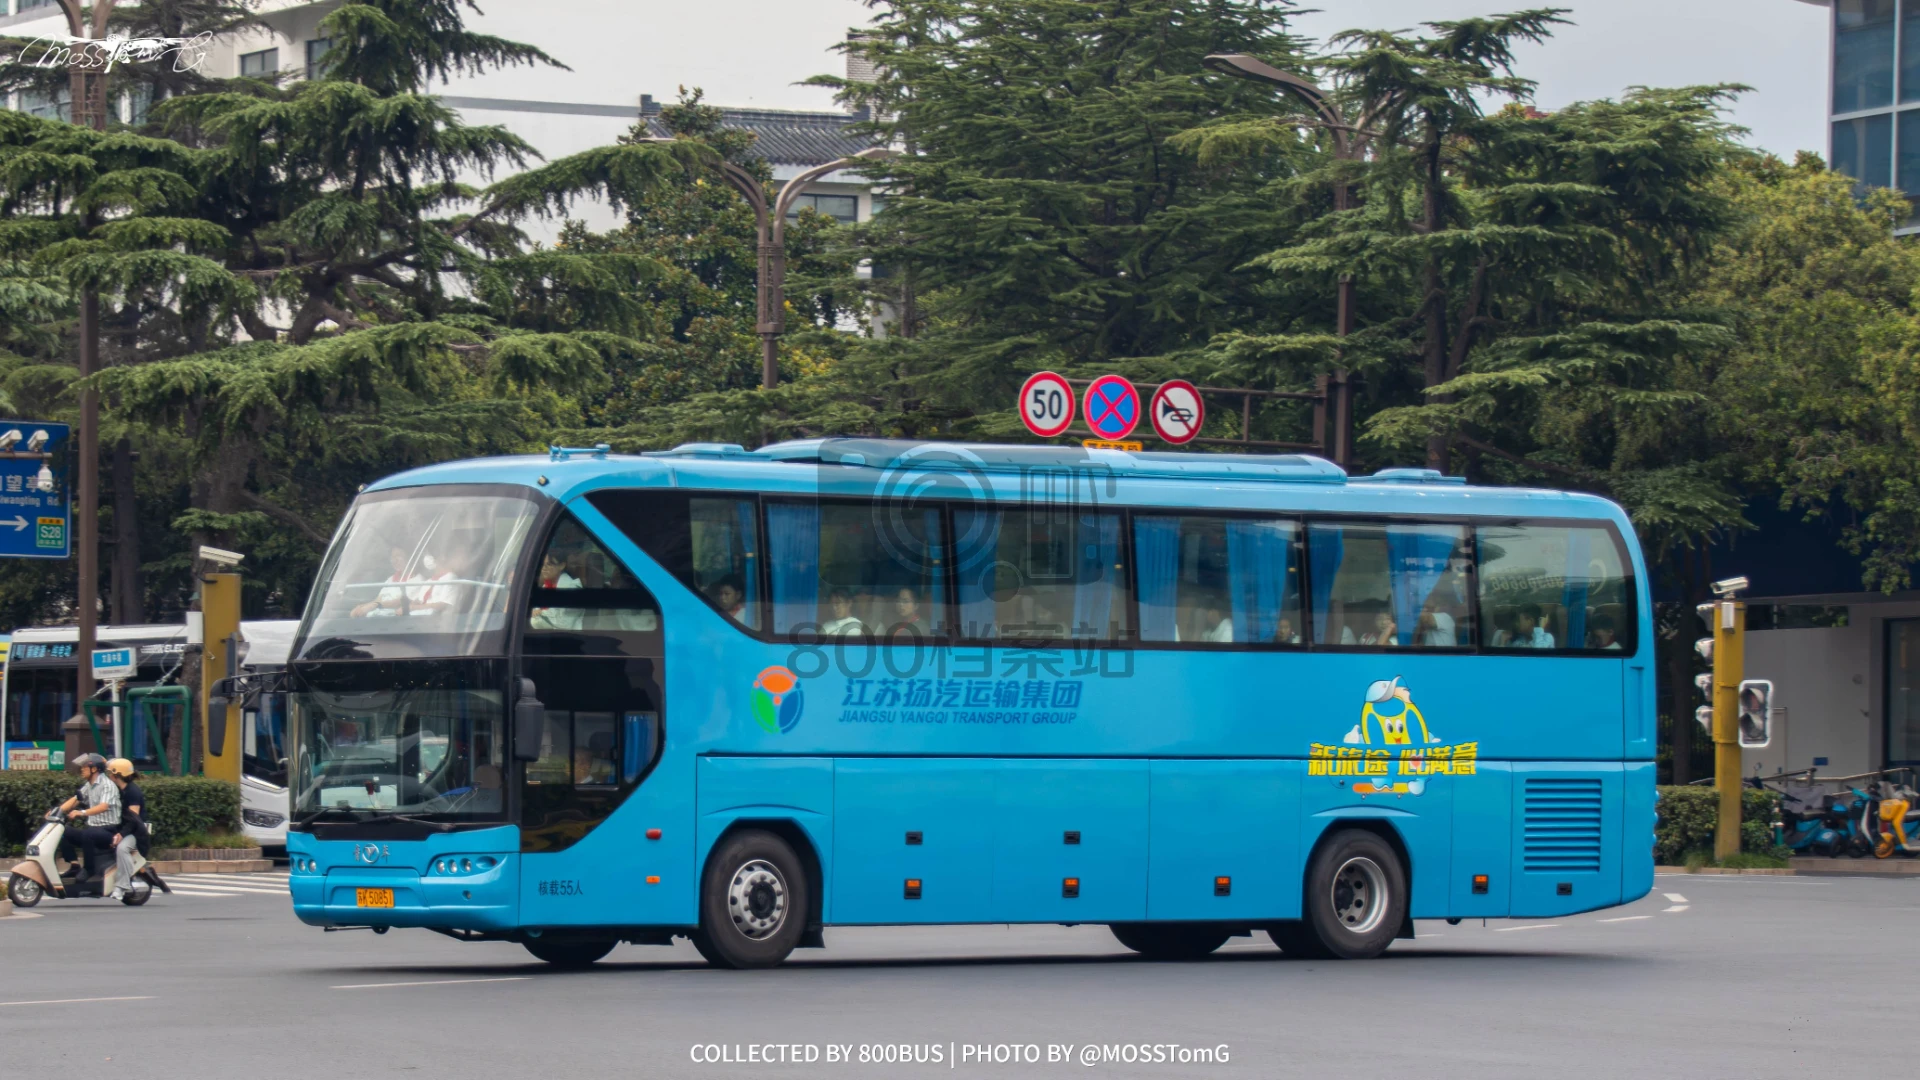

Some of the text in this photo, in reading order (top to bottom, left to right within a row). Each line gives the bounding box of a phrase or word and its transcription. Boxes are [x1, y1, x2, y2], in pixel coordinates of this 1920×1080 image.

[1032, 389, 1062, 420] 50
[40, 525, 62, 539] S28
[842, 678, 1083, 709] 江苏扬汽运输集团
[838, 710, 1077, 725] JIANGSU YANGQI TRANSPORT GROUP
[538, 879, 583, 896] 核载55人
